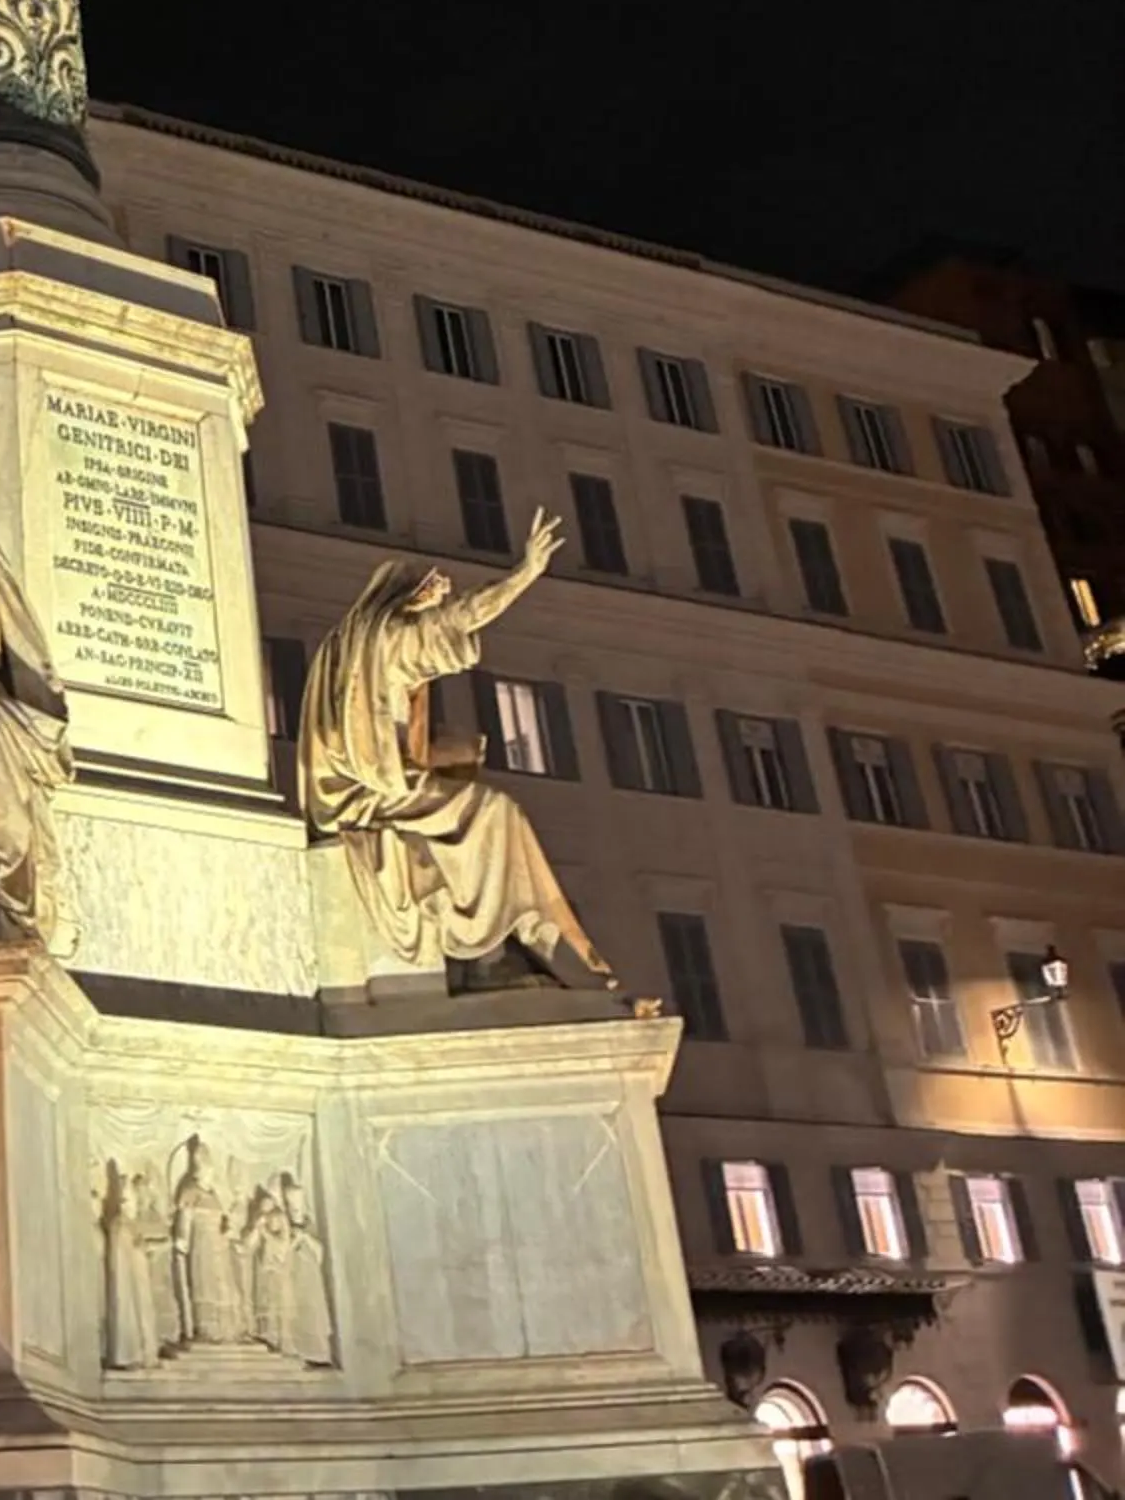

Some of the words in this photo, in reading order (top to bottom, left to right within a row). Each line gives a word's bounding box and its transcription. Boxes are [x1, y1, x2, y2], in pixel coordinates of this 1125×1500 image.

[46, 394, 119, 428] MARIAE
[126, 415, 196, 449] VIRGINI
[57, 423, 152, 463] GENITRICI
[160, 448, 189, 472] DEI
[63, 491, 104, 516] PIVS
